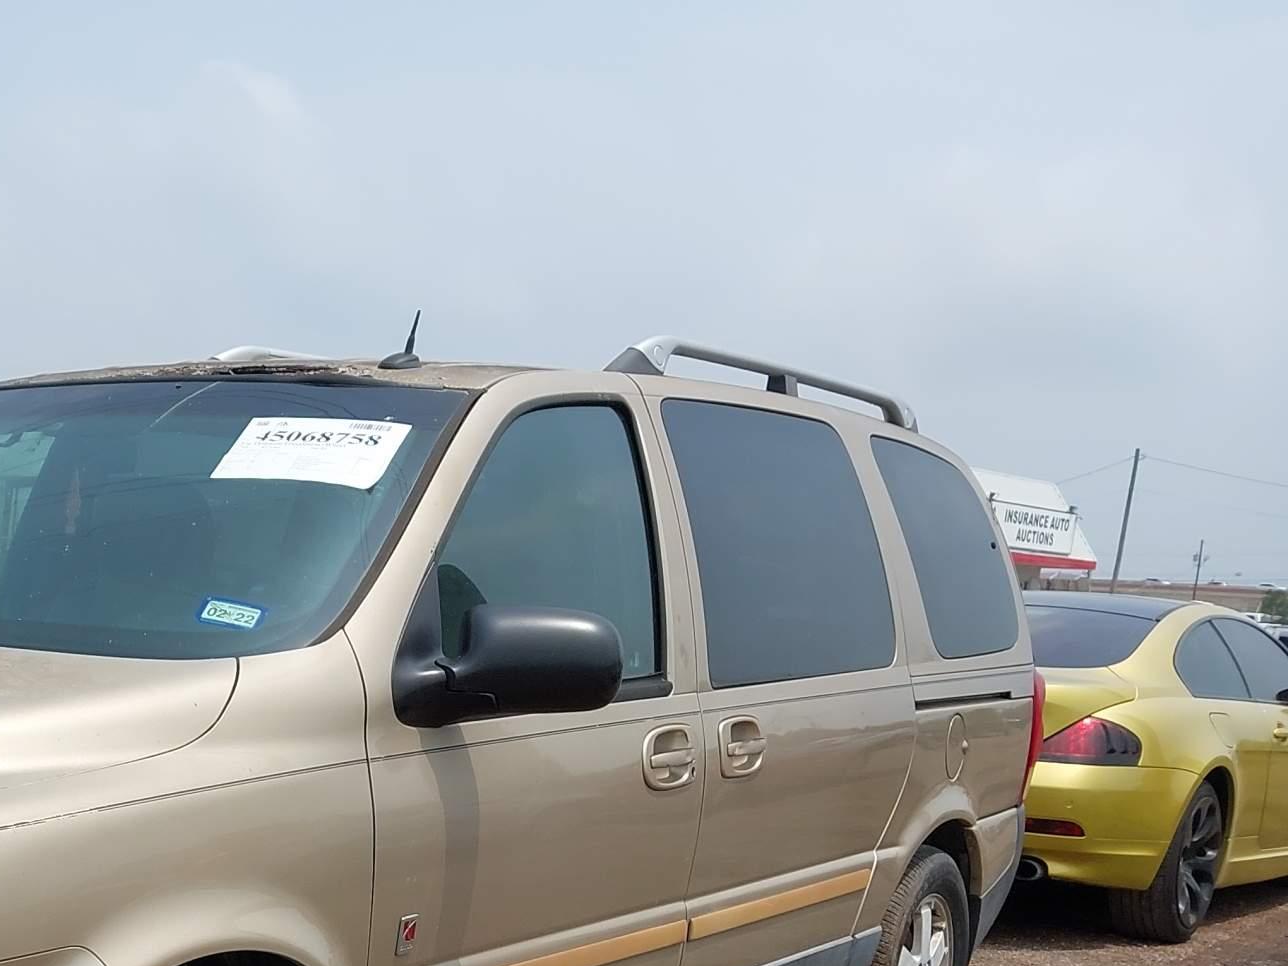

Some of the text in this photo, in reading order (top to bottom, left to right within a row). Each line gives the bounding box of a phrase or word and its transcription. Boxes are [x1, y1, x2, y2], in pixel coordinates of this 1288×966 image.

[255, 430, 382, 447] 45068758
[1004, 508, 1050, 529] INSURANCE
[1049, 515, 1070, 532] AUTO
[1015, 527, 1054, 547] AUCTIONS
[206, 607, 226, 619] 02
[233, 612, 255, 625] 22
